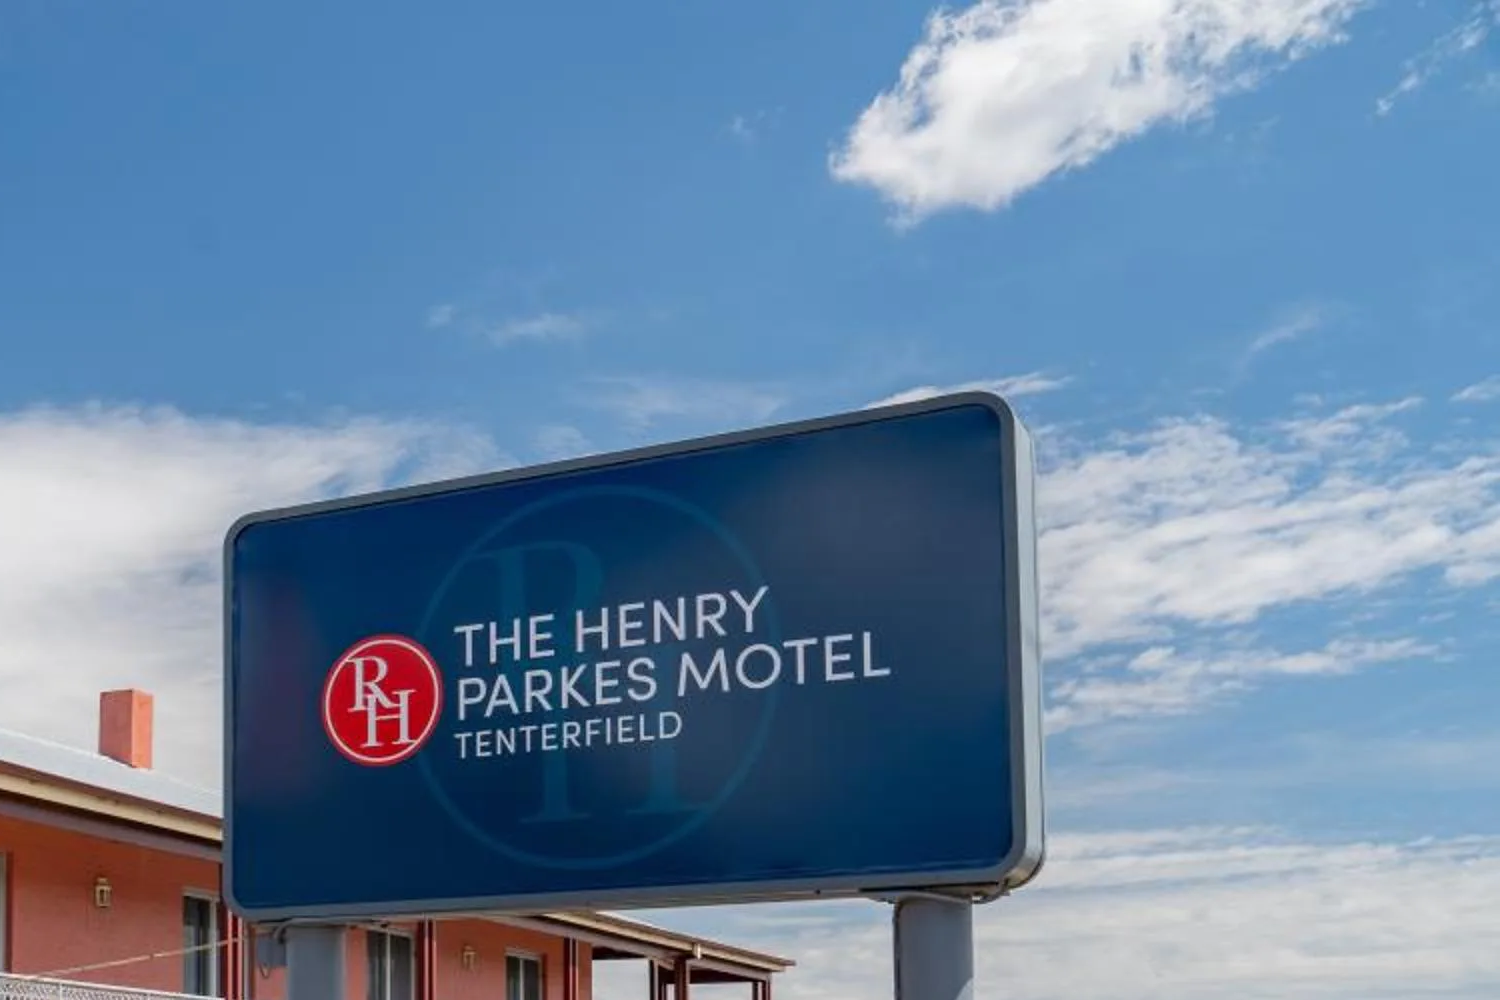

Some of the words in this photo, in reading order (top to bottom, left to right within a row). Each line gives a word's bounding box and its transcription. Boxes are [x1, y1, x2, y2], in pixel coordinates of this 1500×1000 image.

[453, 613, 556, 667] THE
[575, 586, 769, 653] HENRY
[457, 656, 658, 721] PARKES
[677, 631, 891, 697] MOTEL
[454, 711, 683, 759] TENTERFIELD
